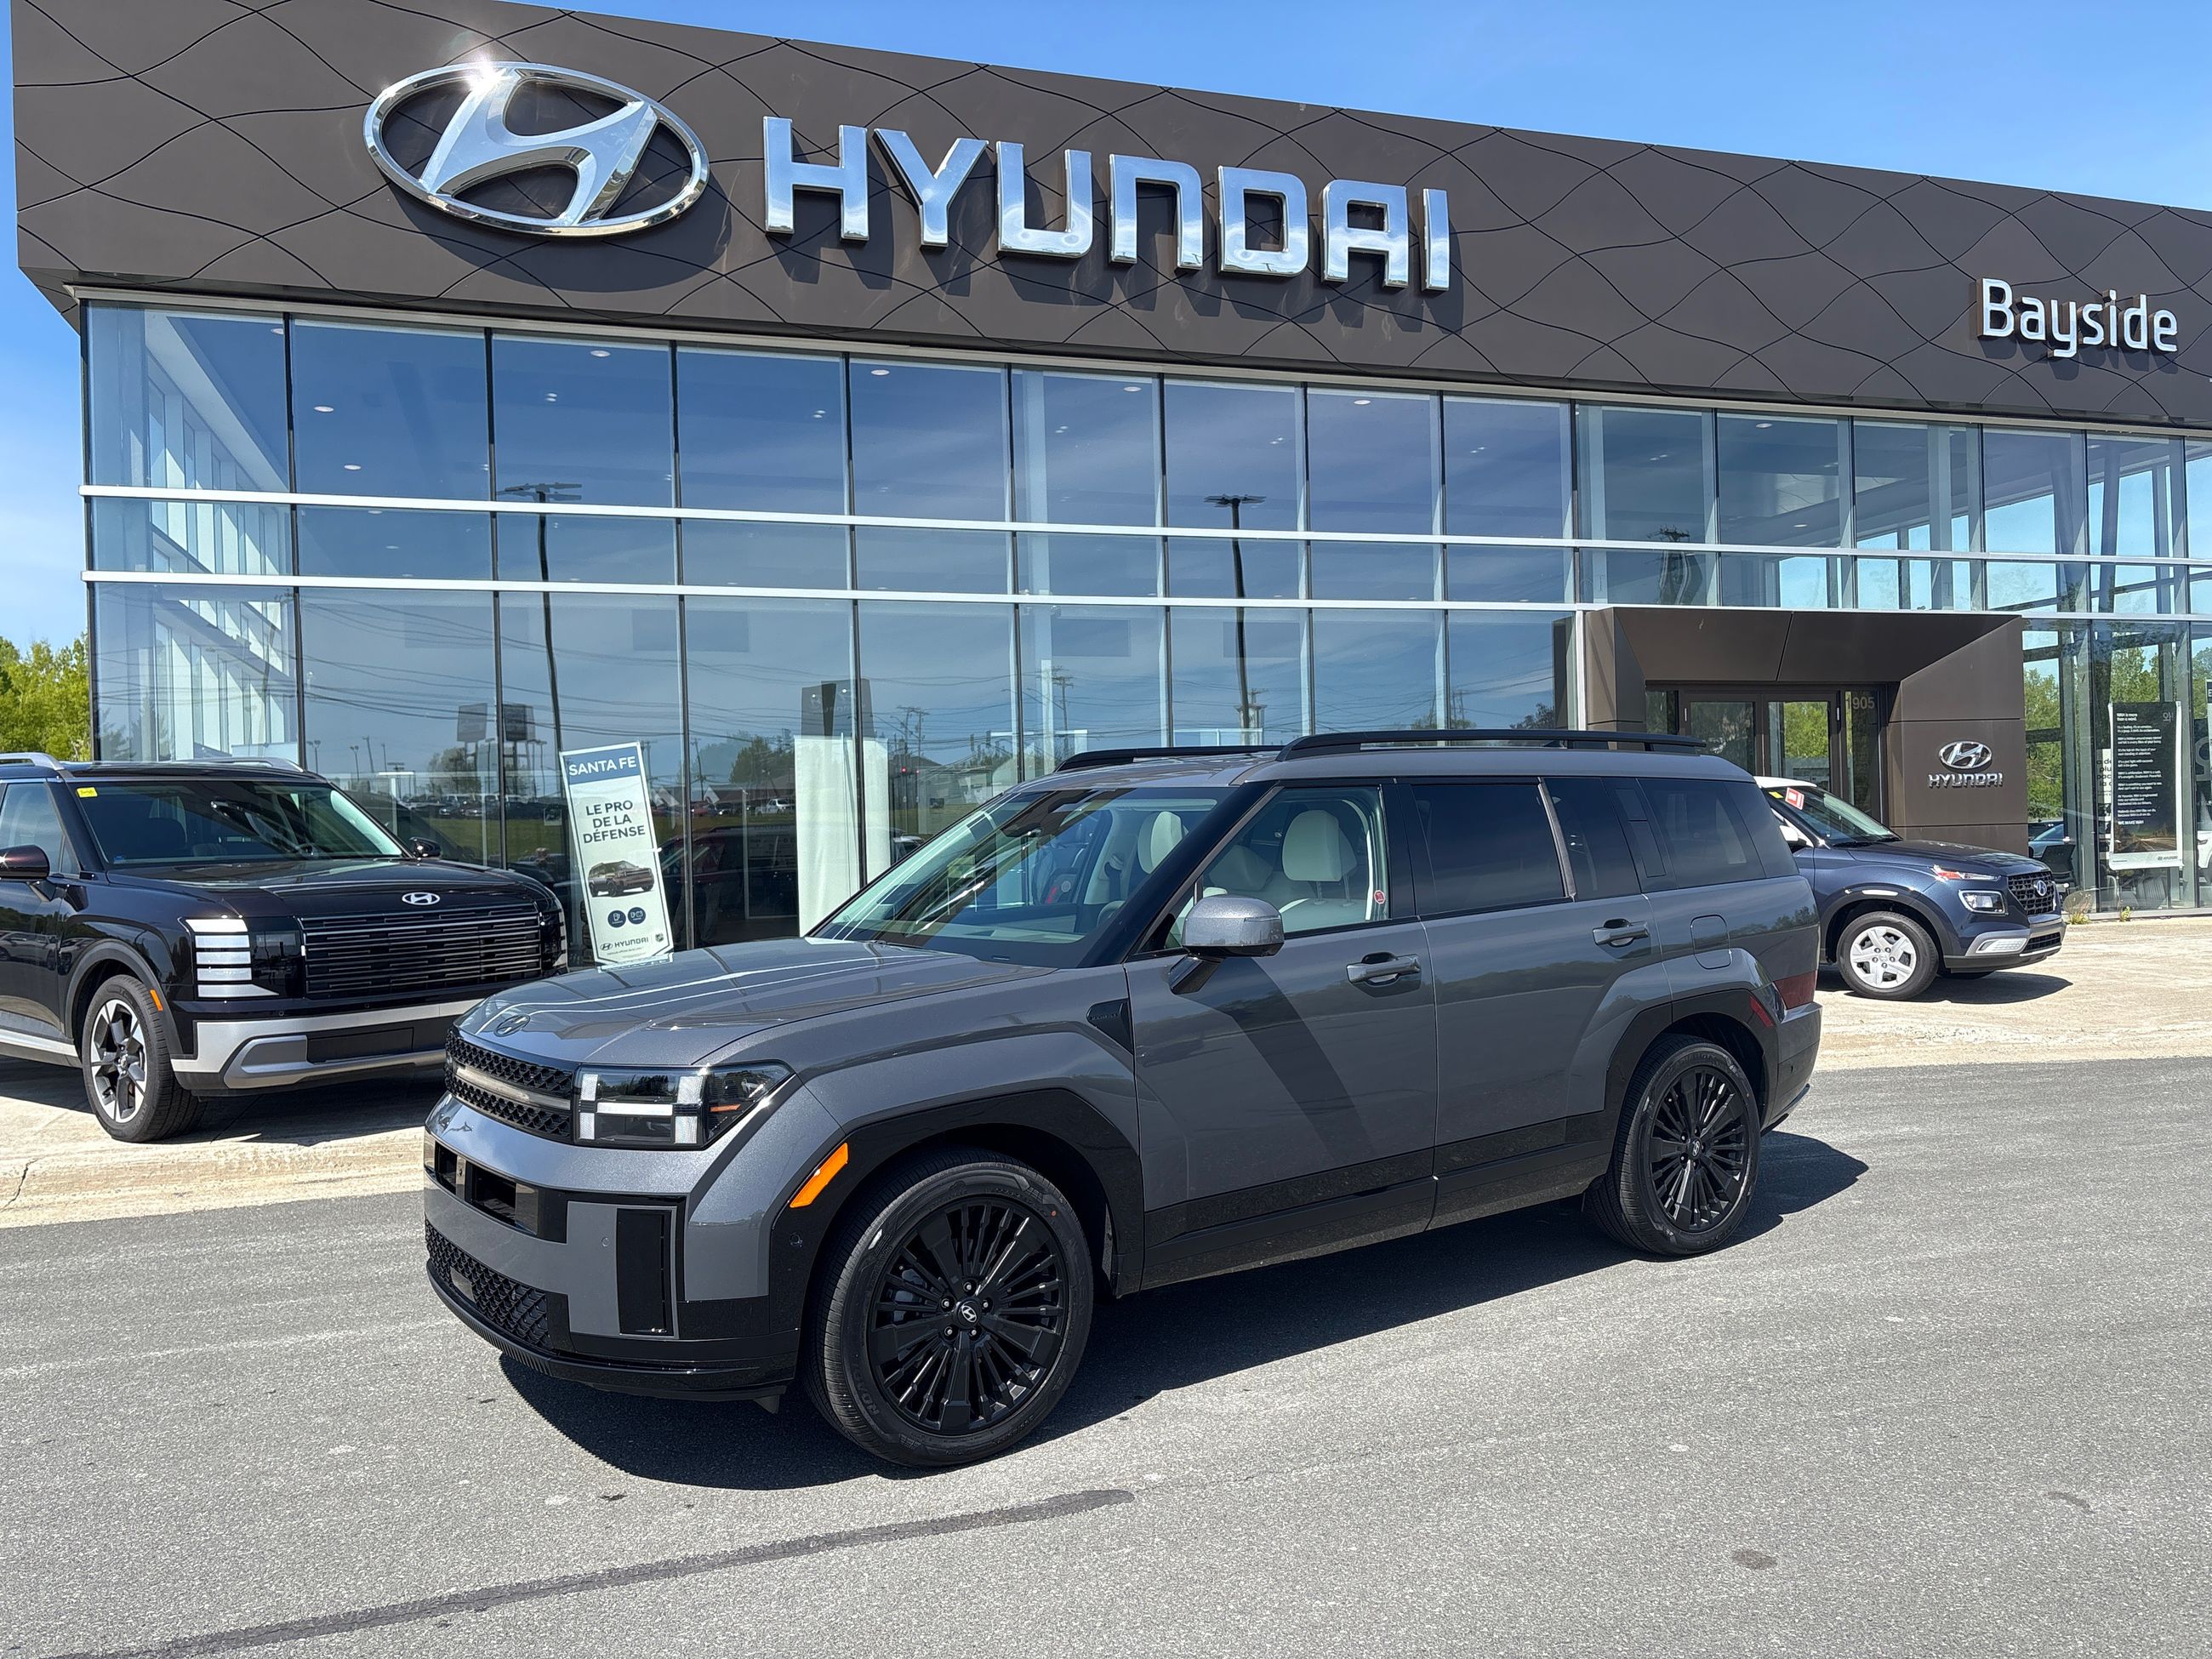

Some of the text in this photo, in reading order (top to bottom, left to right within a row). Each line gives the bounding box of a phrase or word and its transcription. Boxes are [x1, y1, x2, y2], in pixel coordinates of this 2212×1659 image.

[762, 116, 1450, 291] HYUNDAI
[1981, 277, 2178, 358] Bayside
[568, 755, 636, 776] SANTA FE
[1928, 772, 2003, 788] HYUNDAI
[585, 800, 633, 816] LE PRO
[592, 814, 632, 829] DE LA
[583, 825, 646, 844] DÉFENSE
[614, 937, 648, 948] HYUNDAI
